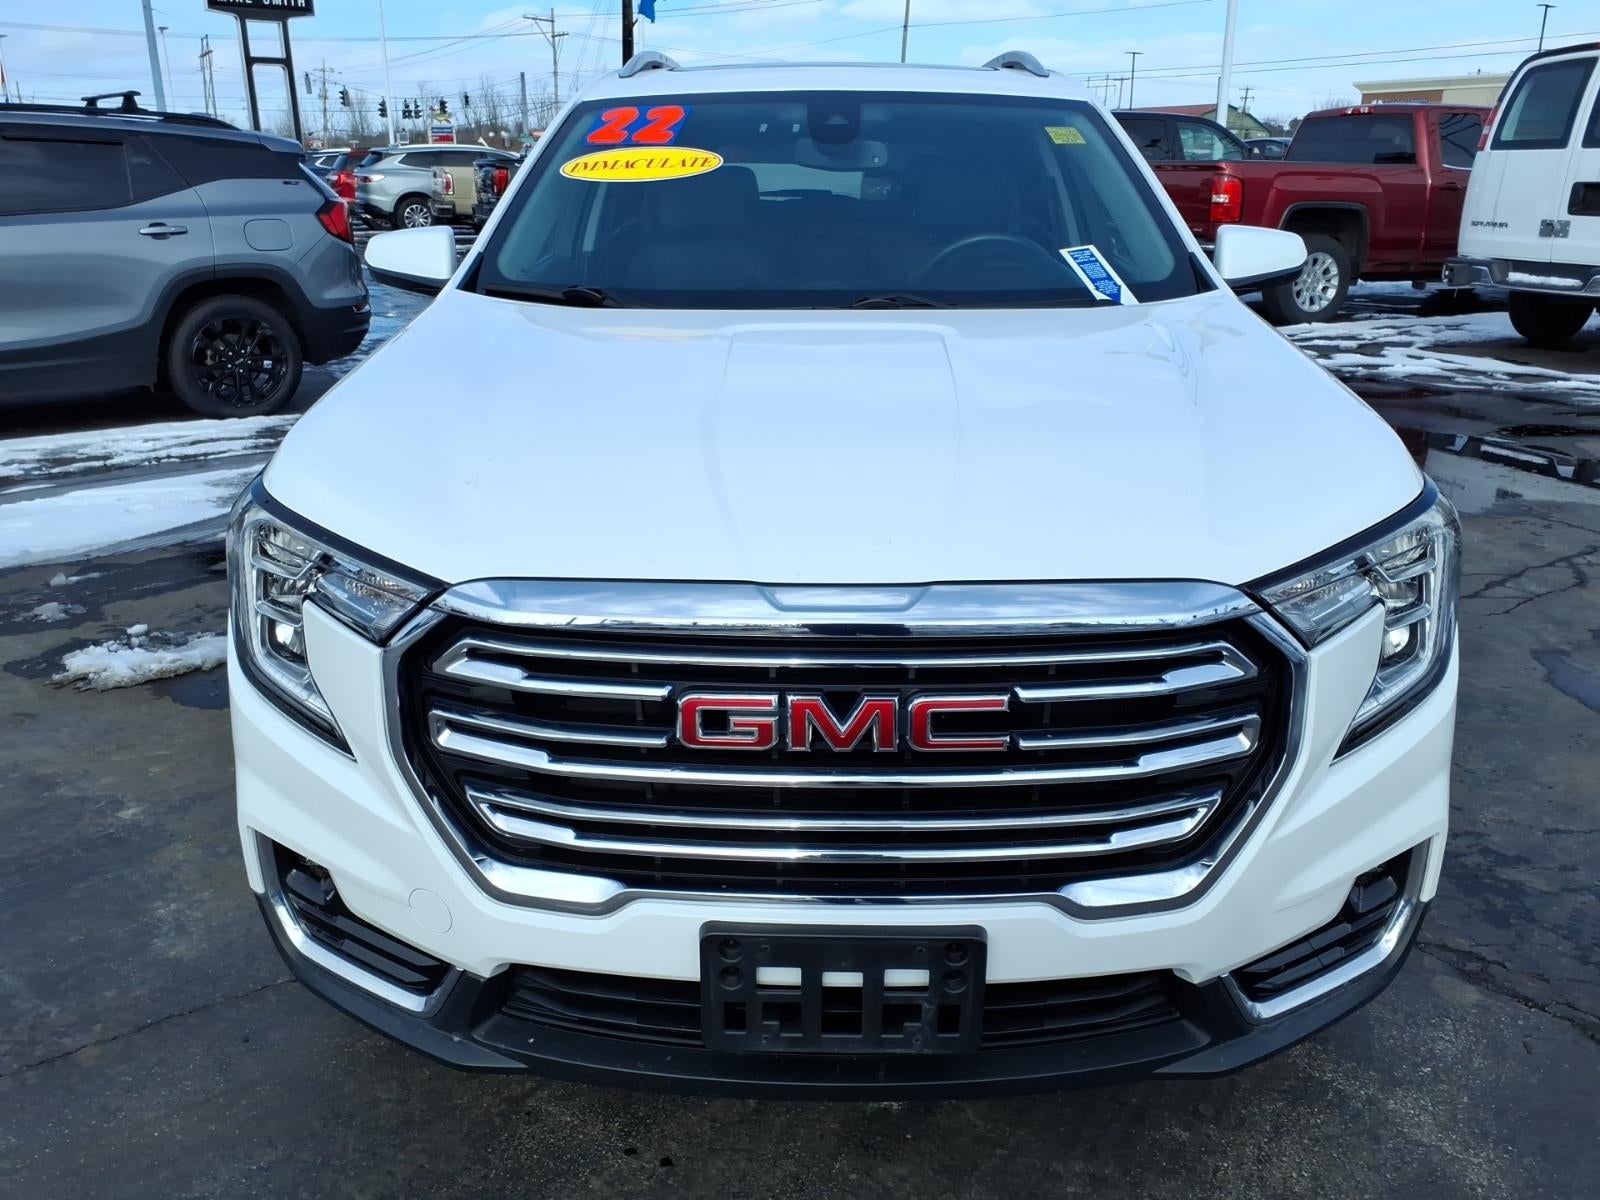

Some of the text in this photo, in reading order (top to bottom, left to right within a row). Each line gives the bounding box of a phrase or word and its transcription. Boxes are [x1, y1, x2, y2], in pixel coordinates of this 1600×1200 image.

[586, 105, 686, 145] 22
[569, 156, 718, 173] IMMACULATE
[676, 692, 1011, 753] GMC
